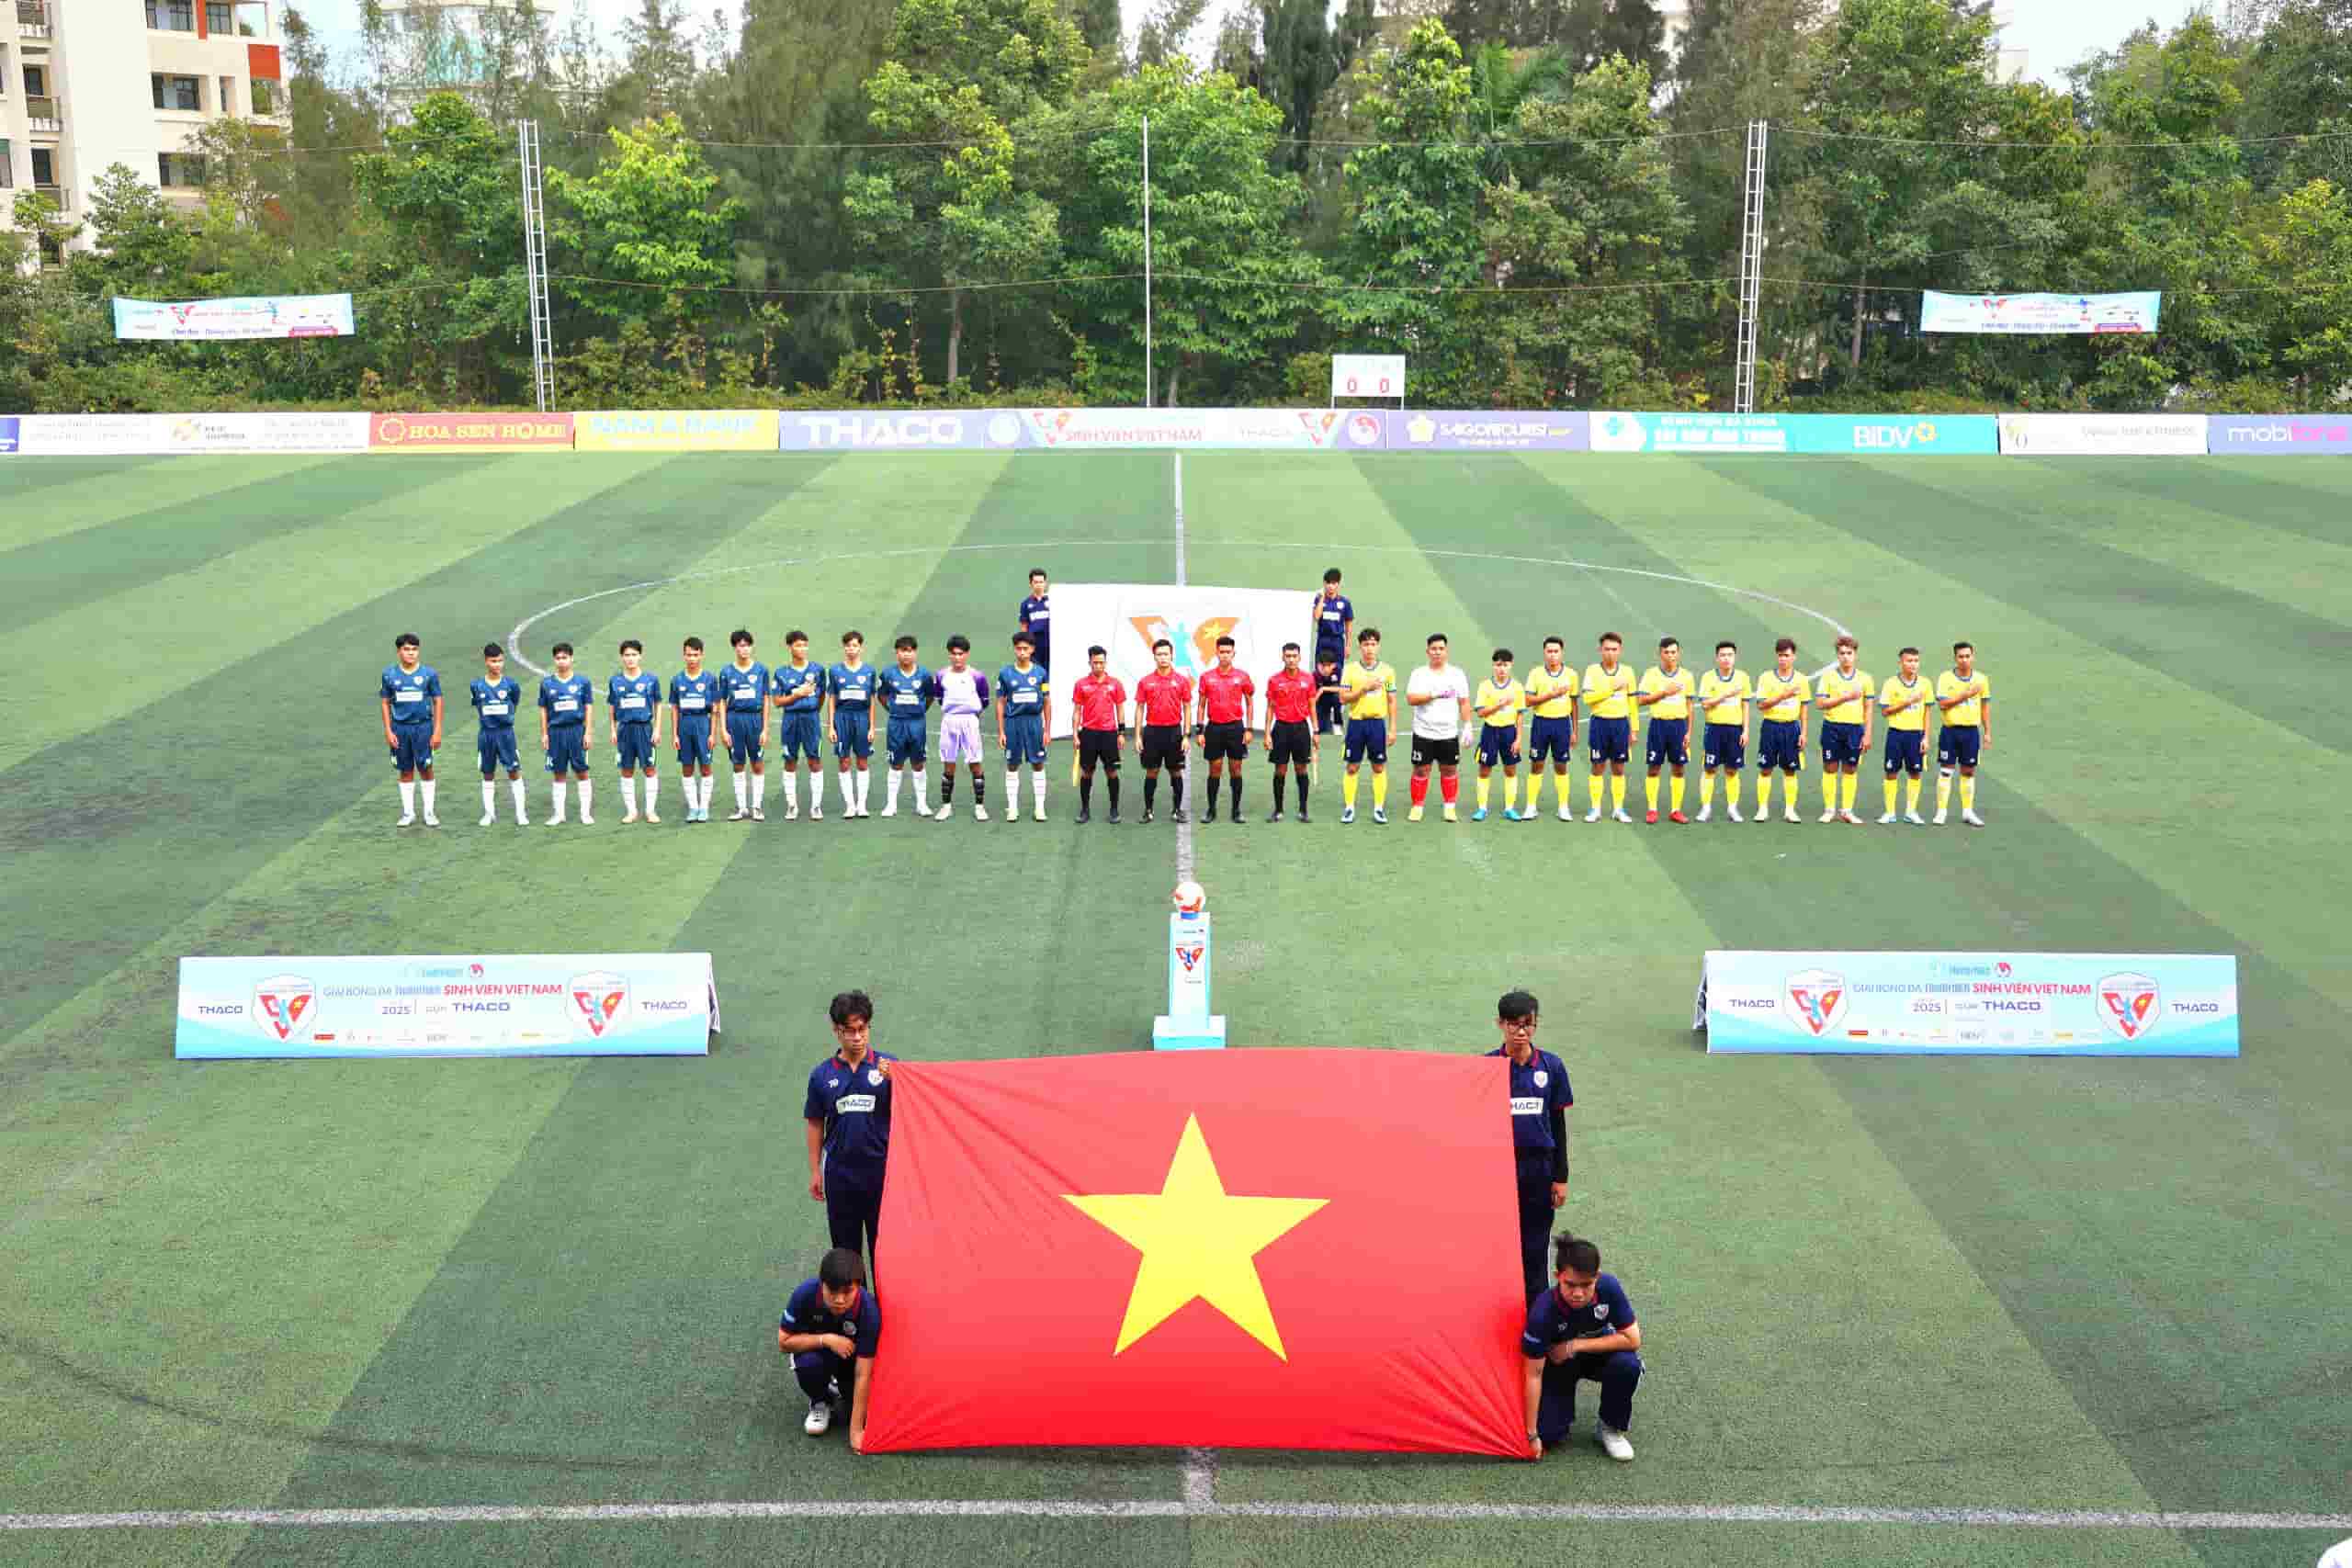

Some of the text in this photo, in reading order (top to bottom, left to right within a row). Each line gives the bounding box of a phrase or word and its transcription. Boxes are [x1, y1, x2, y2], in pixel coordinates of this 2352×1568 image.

[1346, 377, 1358, 394] 0
[1379, 378, 1390, 394] 0
[800, 415, 964, 446] THACO
[1853, 425, 1914, 448] BIDV
[443, 984, 473, 996] SINH
[531, 984, 562, 995] NAM
[1973, 983, 2002, 994] SINH
[2061, 983, 2091, 994] NAM
[198, 1005, 243, 1014] THACO
[381, 1006, 412, 1015] 2025
[452, 1002, 511, 1012] THACO
[642, 1001, 687, 1011] THACO
[1730, 998, 1775, 1009] THACO
[1912, 1002, 1941, 1013] 2025
[1983, 1001, 2041, 1011] THACO
[2173, 1003, 2219, 1012] THACO
